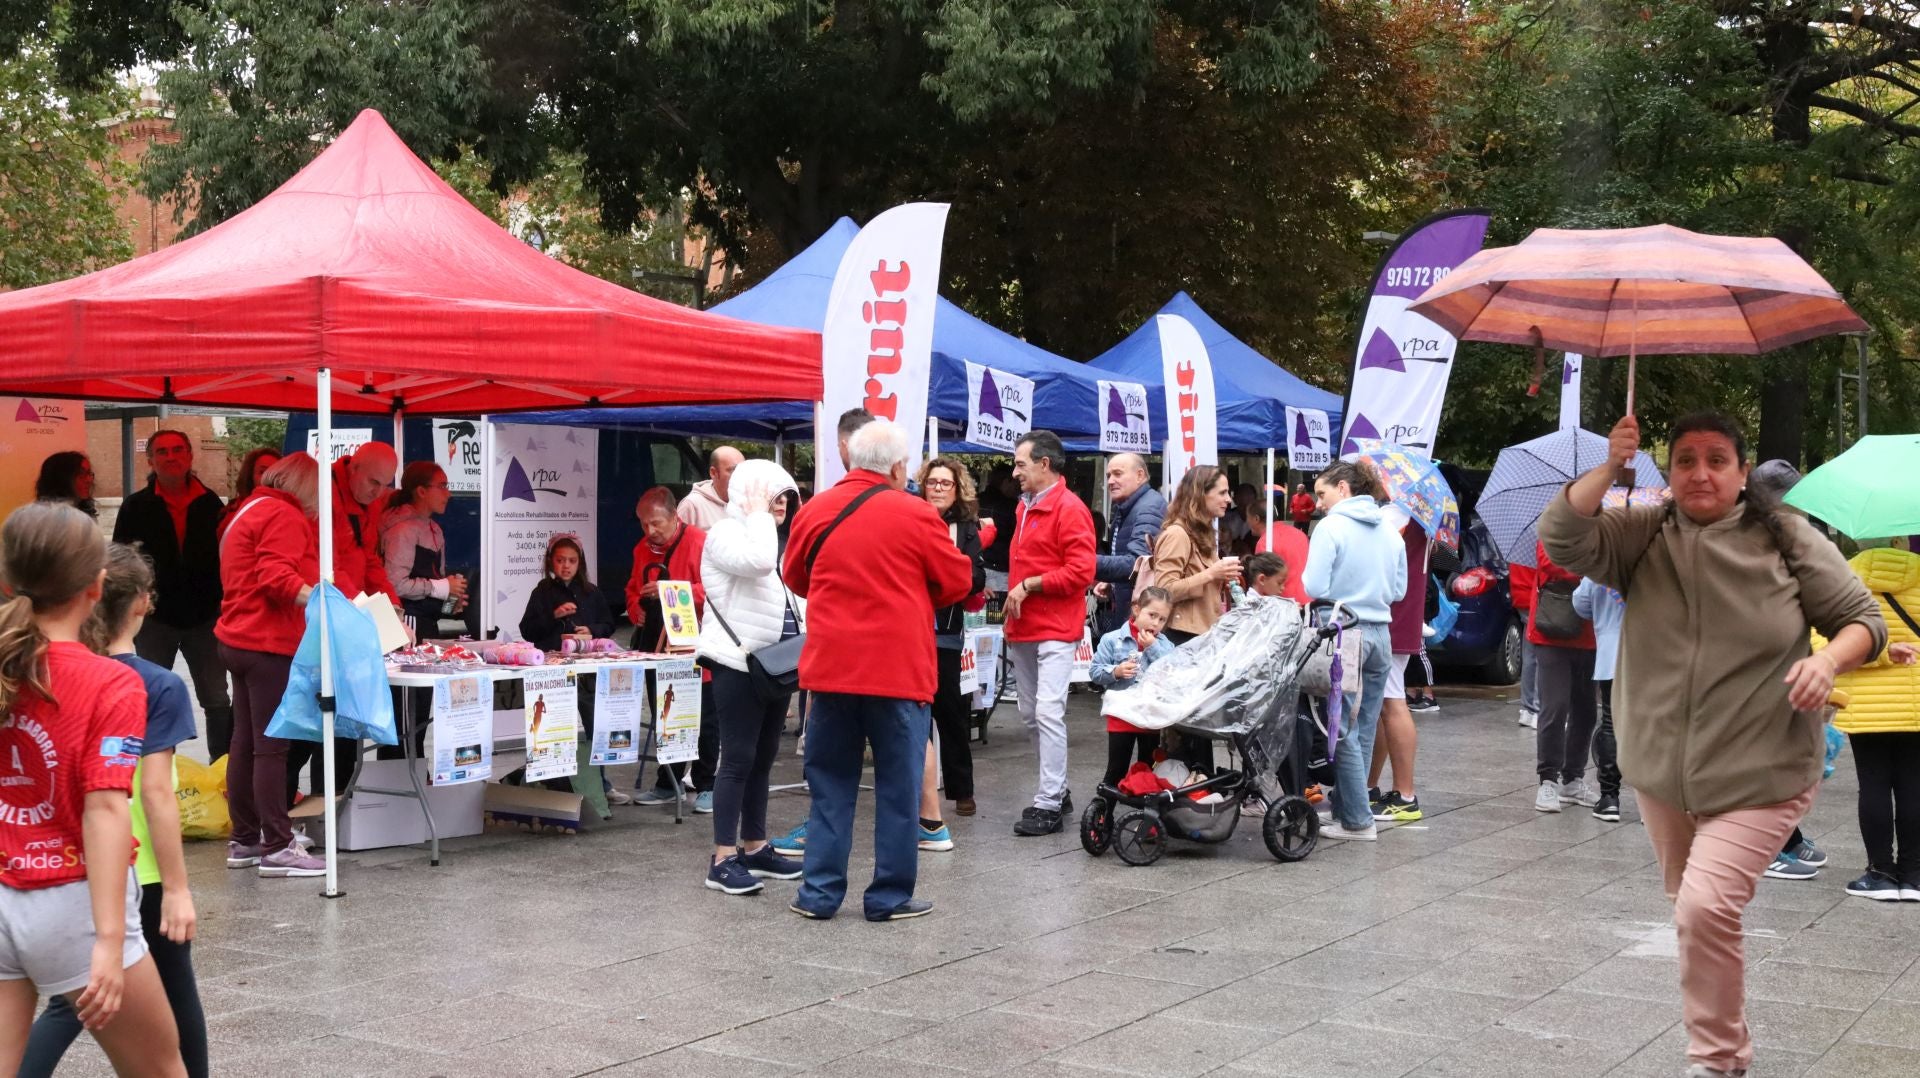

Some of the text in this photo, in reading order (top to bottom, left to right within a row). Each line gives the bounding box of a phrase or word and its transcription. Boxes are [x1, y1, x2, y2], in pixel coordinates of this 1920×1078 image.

[1386, 267, 1412, 288] 979
[1414, 267, 1431, 287] 72
[977, 421, 993, 437] 979
[994, 426, 1004, 440] 72
[1106, 430, 1119, 444] 979
[1120, 431, 1129, 444] 72
[1129, 432, 1139, 445] 89
[462, 441, 482, 466] Re
[1294, 452, 1306, 462] 979
[1306, 452, 1314, 463] 72
[1322, 453, 1329, 463] 5
[463, 468, 482, 476] VEHIC
[456, 481, 465, 490] 72
[466, 482, 475, 491] 96
[476, 483, 482, 491] 6
[525, 511, 560, 519] Rehabilitados
[560, 511, 568, 519] de
[568, 511, 589, 519] Palencia
[507, 531, 524, 540] Avda.
[526, 531, 535, 539] de
[536, 531, 548, 539] San
[515, 541, 548, 551] 34004 PAL
[503, 565, 544, 577] arpapalencia
[17, 715, 59, 770] SABOREA
